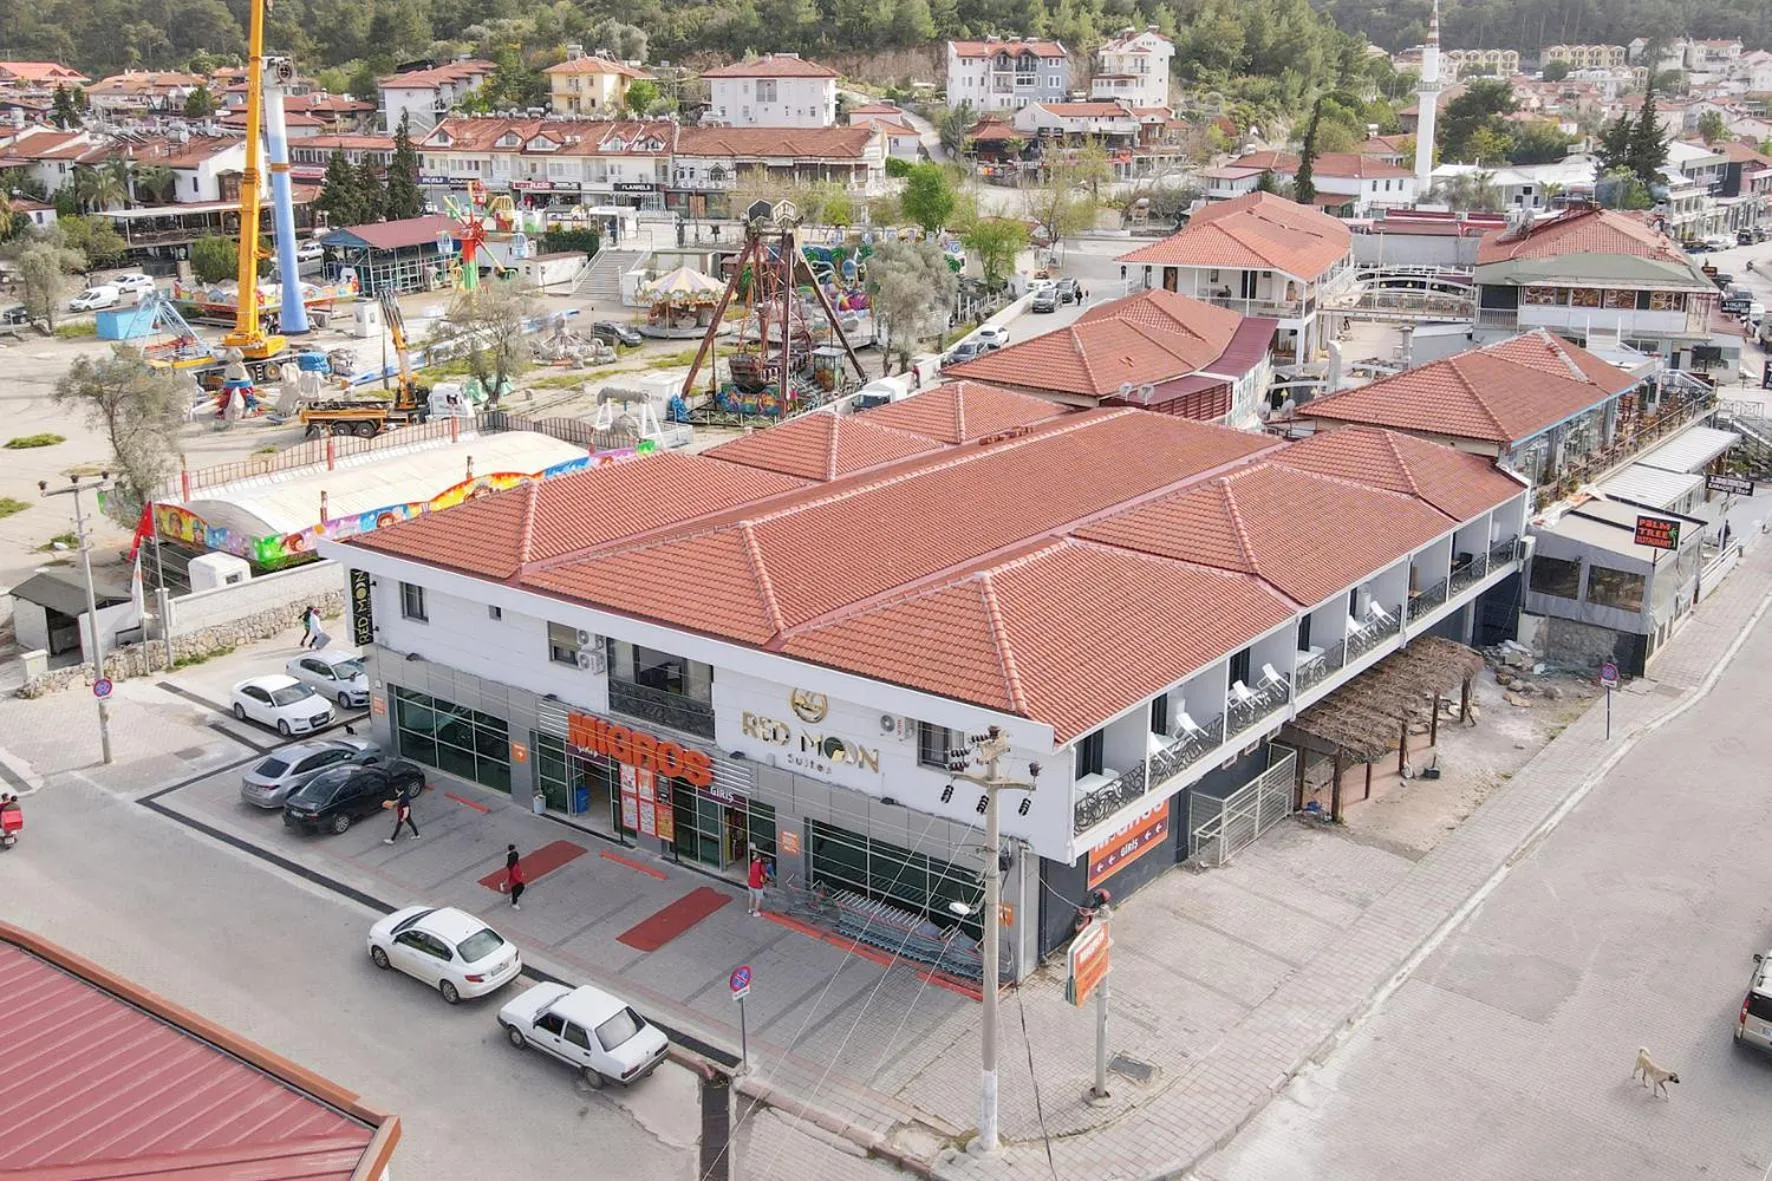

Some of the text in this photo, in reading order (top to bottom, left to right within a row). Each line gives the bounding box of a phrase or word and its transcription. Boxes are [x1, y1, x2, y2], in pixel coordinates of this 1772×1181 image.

[1638, 527, 1668, 539] TREE
[357, 617, 370, 644] RED
[742, 710, 791, 746] RED
[567, 710, 714, 787] MIGROS
